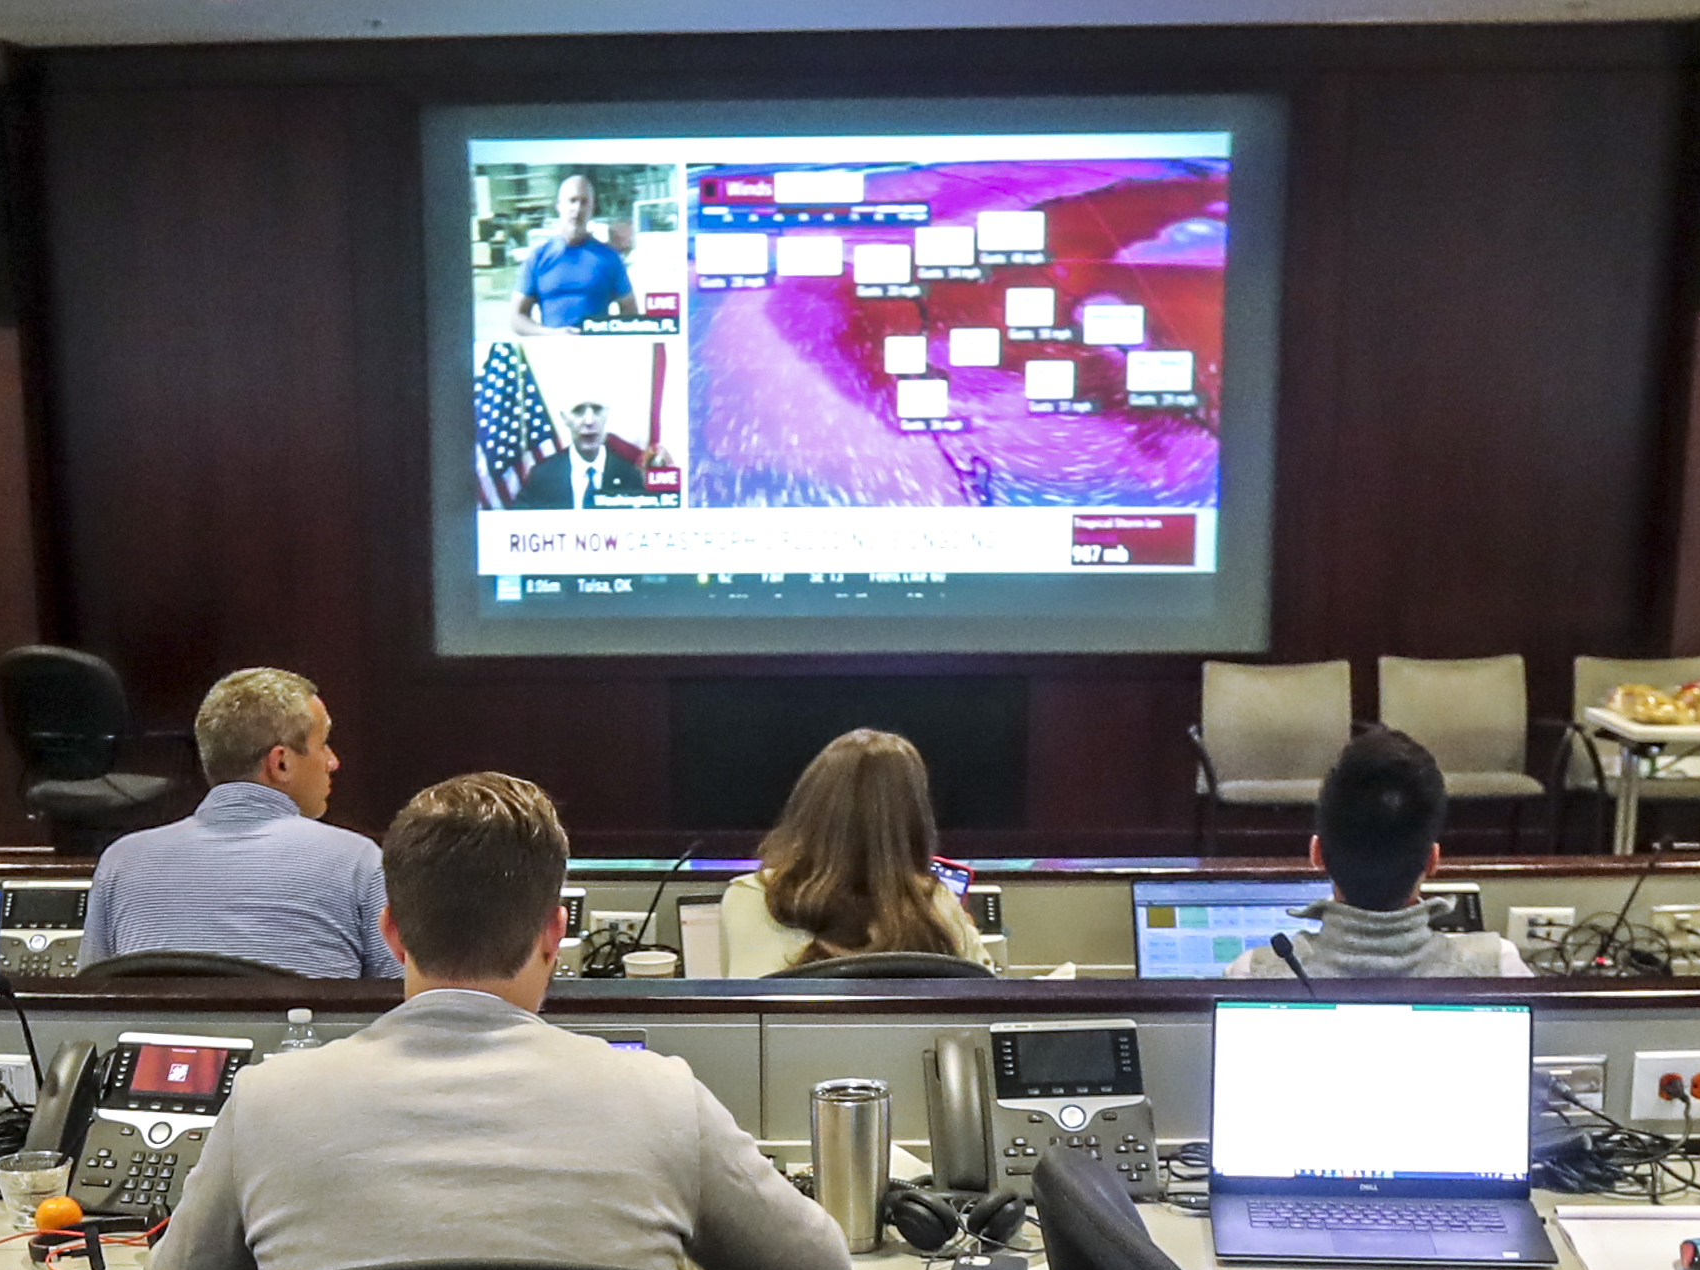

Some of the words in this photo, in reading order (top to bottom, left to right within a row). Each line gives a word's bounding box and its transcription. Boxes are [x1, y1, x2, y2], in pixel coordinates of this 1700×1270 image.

[647, 296, 677, 310] LIVE
[648, 471, 678, 484] LIVE
[510, 533, 566, 552] RIGHT
[575, 533, 618, 551] NOW
[625, 532, 775, 551] CATASTROPHC
